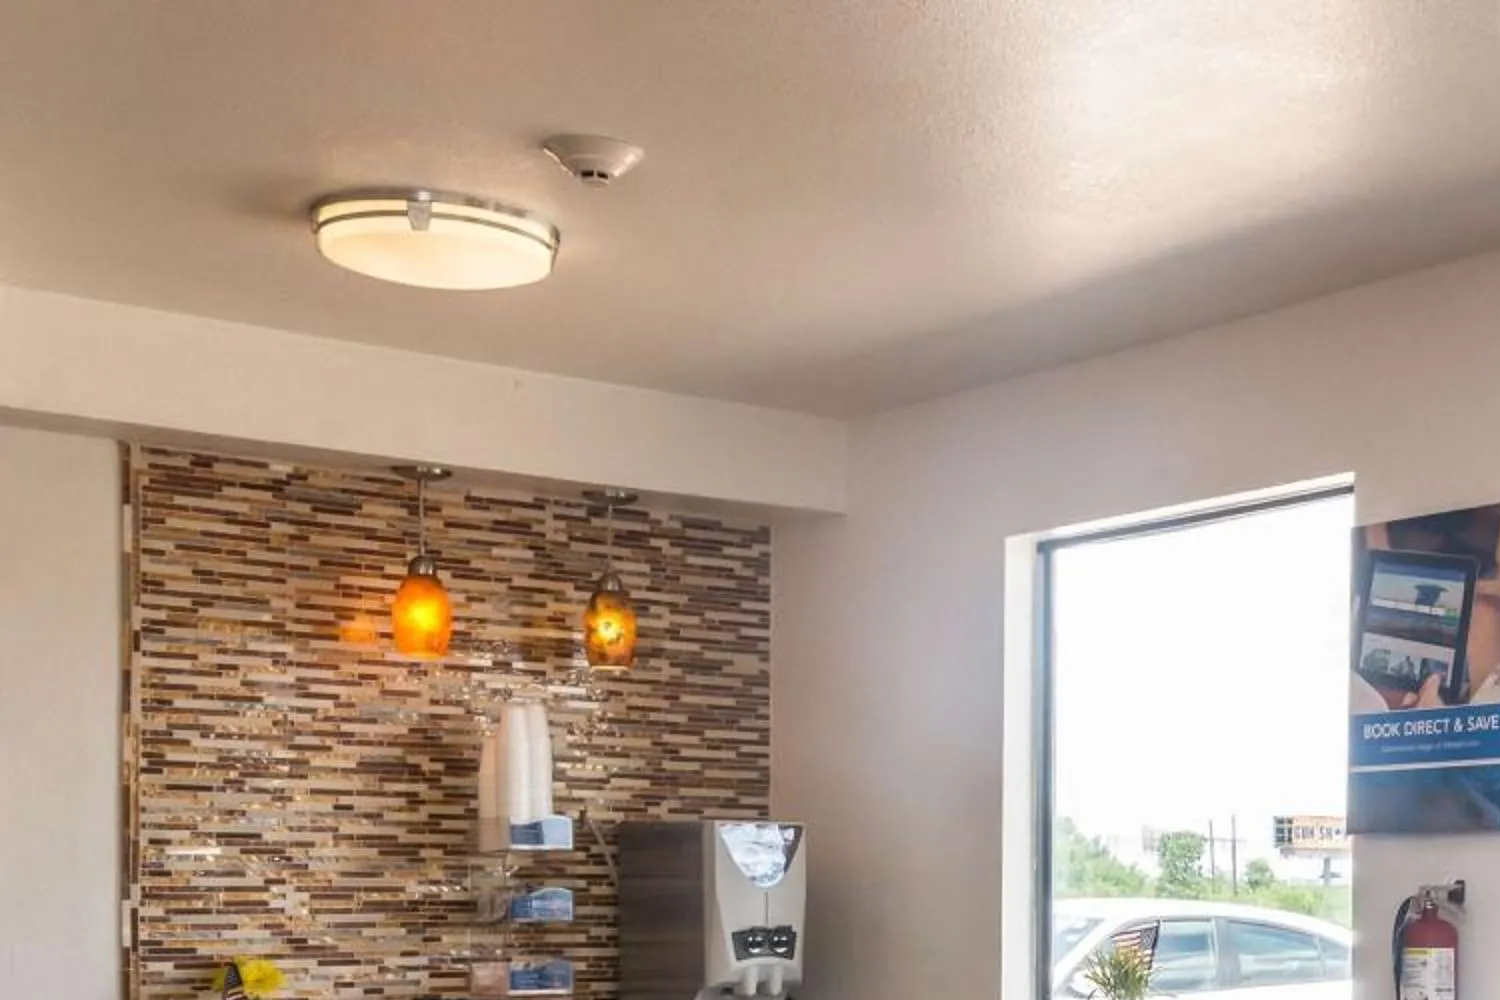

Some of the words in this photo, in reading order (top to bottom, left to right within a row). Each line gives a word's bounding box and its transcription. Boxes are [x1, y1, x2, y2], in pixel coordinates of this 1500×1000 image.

[1363, 723, 1400, 740] BOOK
[1403, 719, 1451, 737] DIRECT
[1453, 717, 1463, 733] &
[1467, 714, 1500, 732] SAVE
